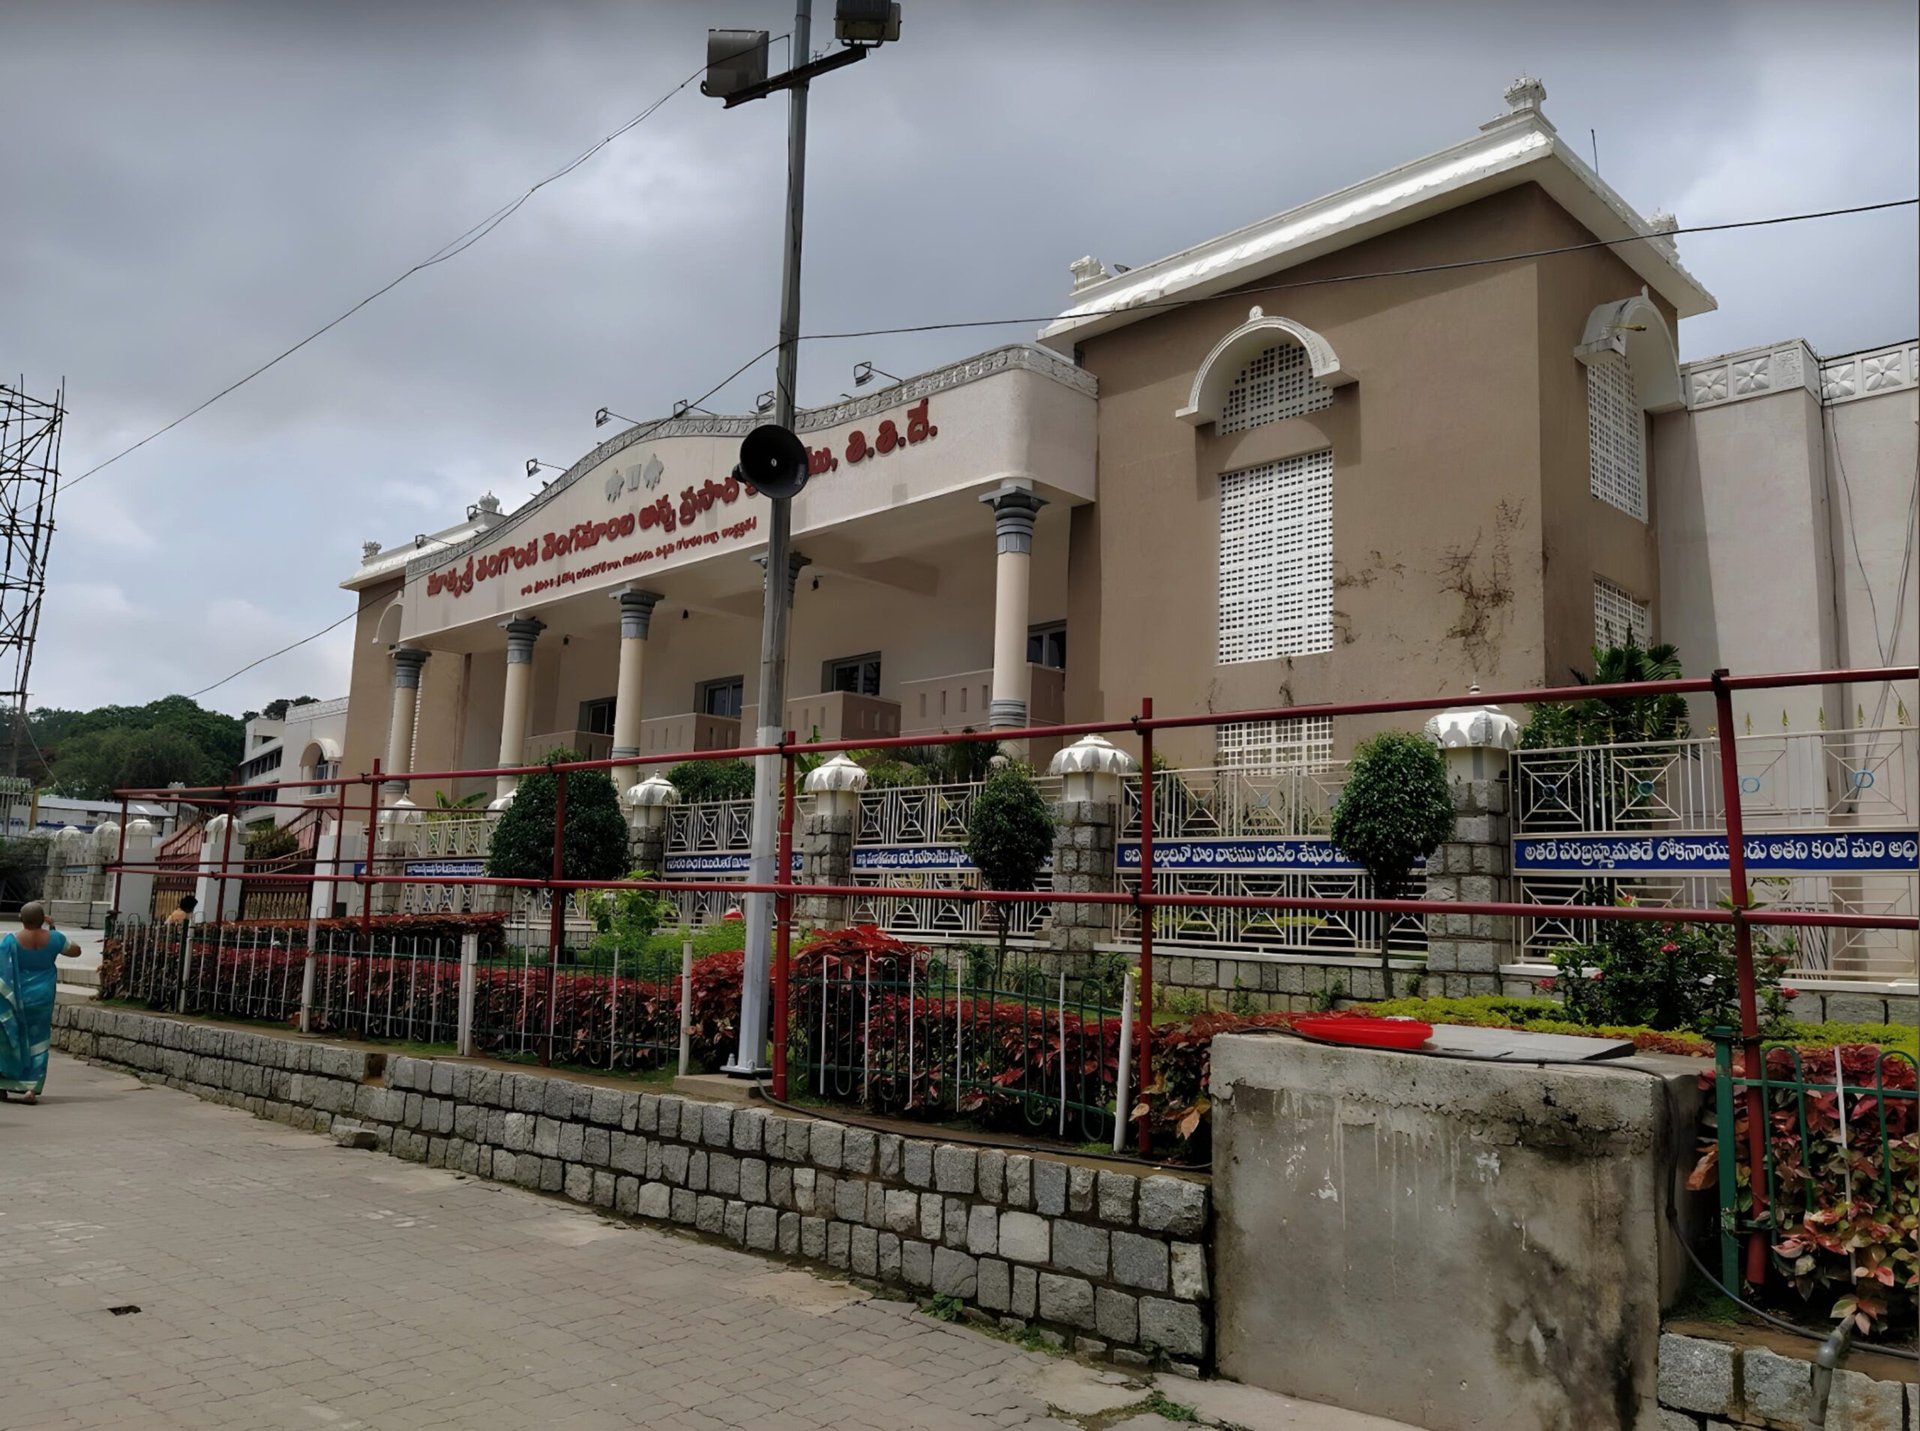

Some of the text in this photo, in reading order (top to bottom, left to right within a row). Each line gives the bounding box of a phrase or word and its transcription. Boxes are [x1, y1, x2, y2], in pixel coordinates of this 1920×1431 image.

[1524, 840, 1558, 861] అతడే
[1657, 839, 1767, 861] లోకనాయడు
[1769, 839, 1808, 860] అతని
[1811, 834, 1849, 860] కంటే
[1851, 838, 1885, 859] మరి
